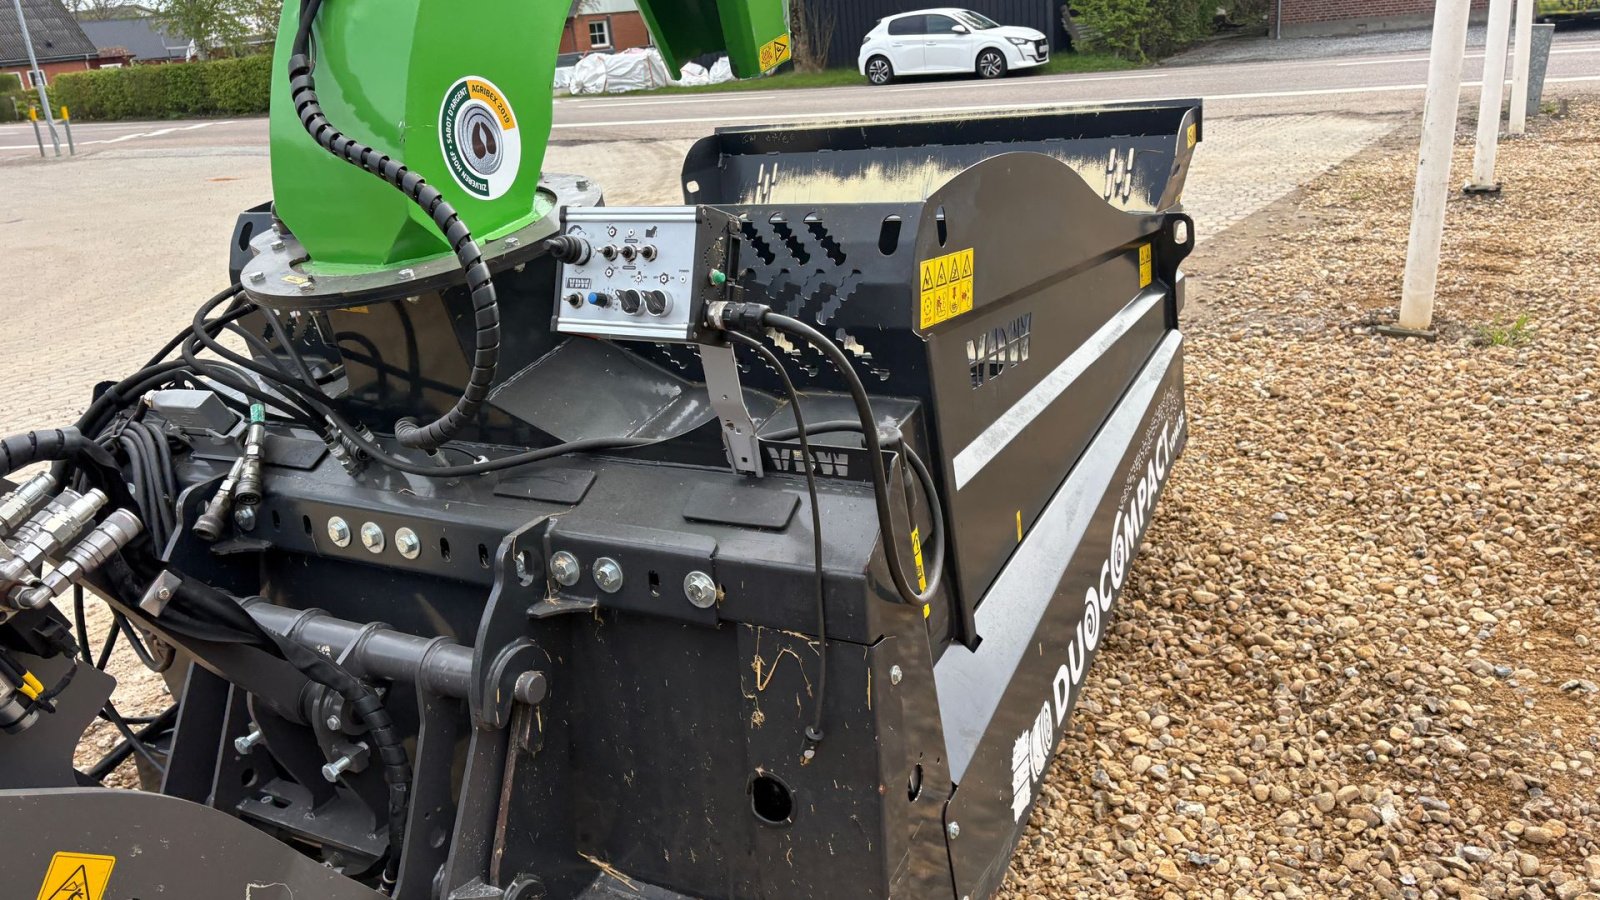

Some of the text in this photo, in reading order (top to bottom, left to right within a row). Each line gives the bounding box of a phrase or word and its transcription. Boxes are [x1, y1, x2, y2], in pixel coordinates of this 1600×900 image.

[445, 86, 487, 192] ZILVEREN HOEF SABOT D'ARGENT
[471, 84, 510, 124] AGRIBEX 2019
